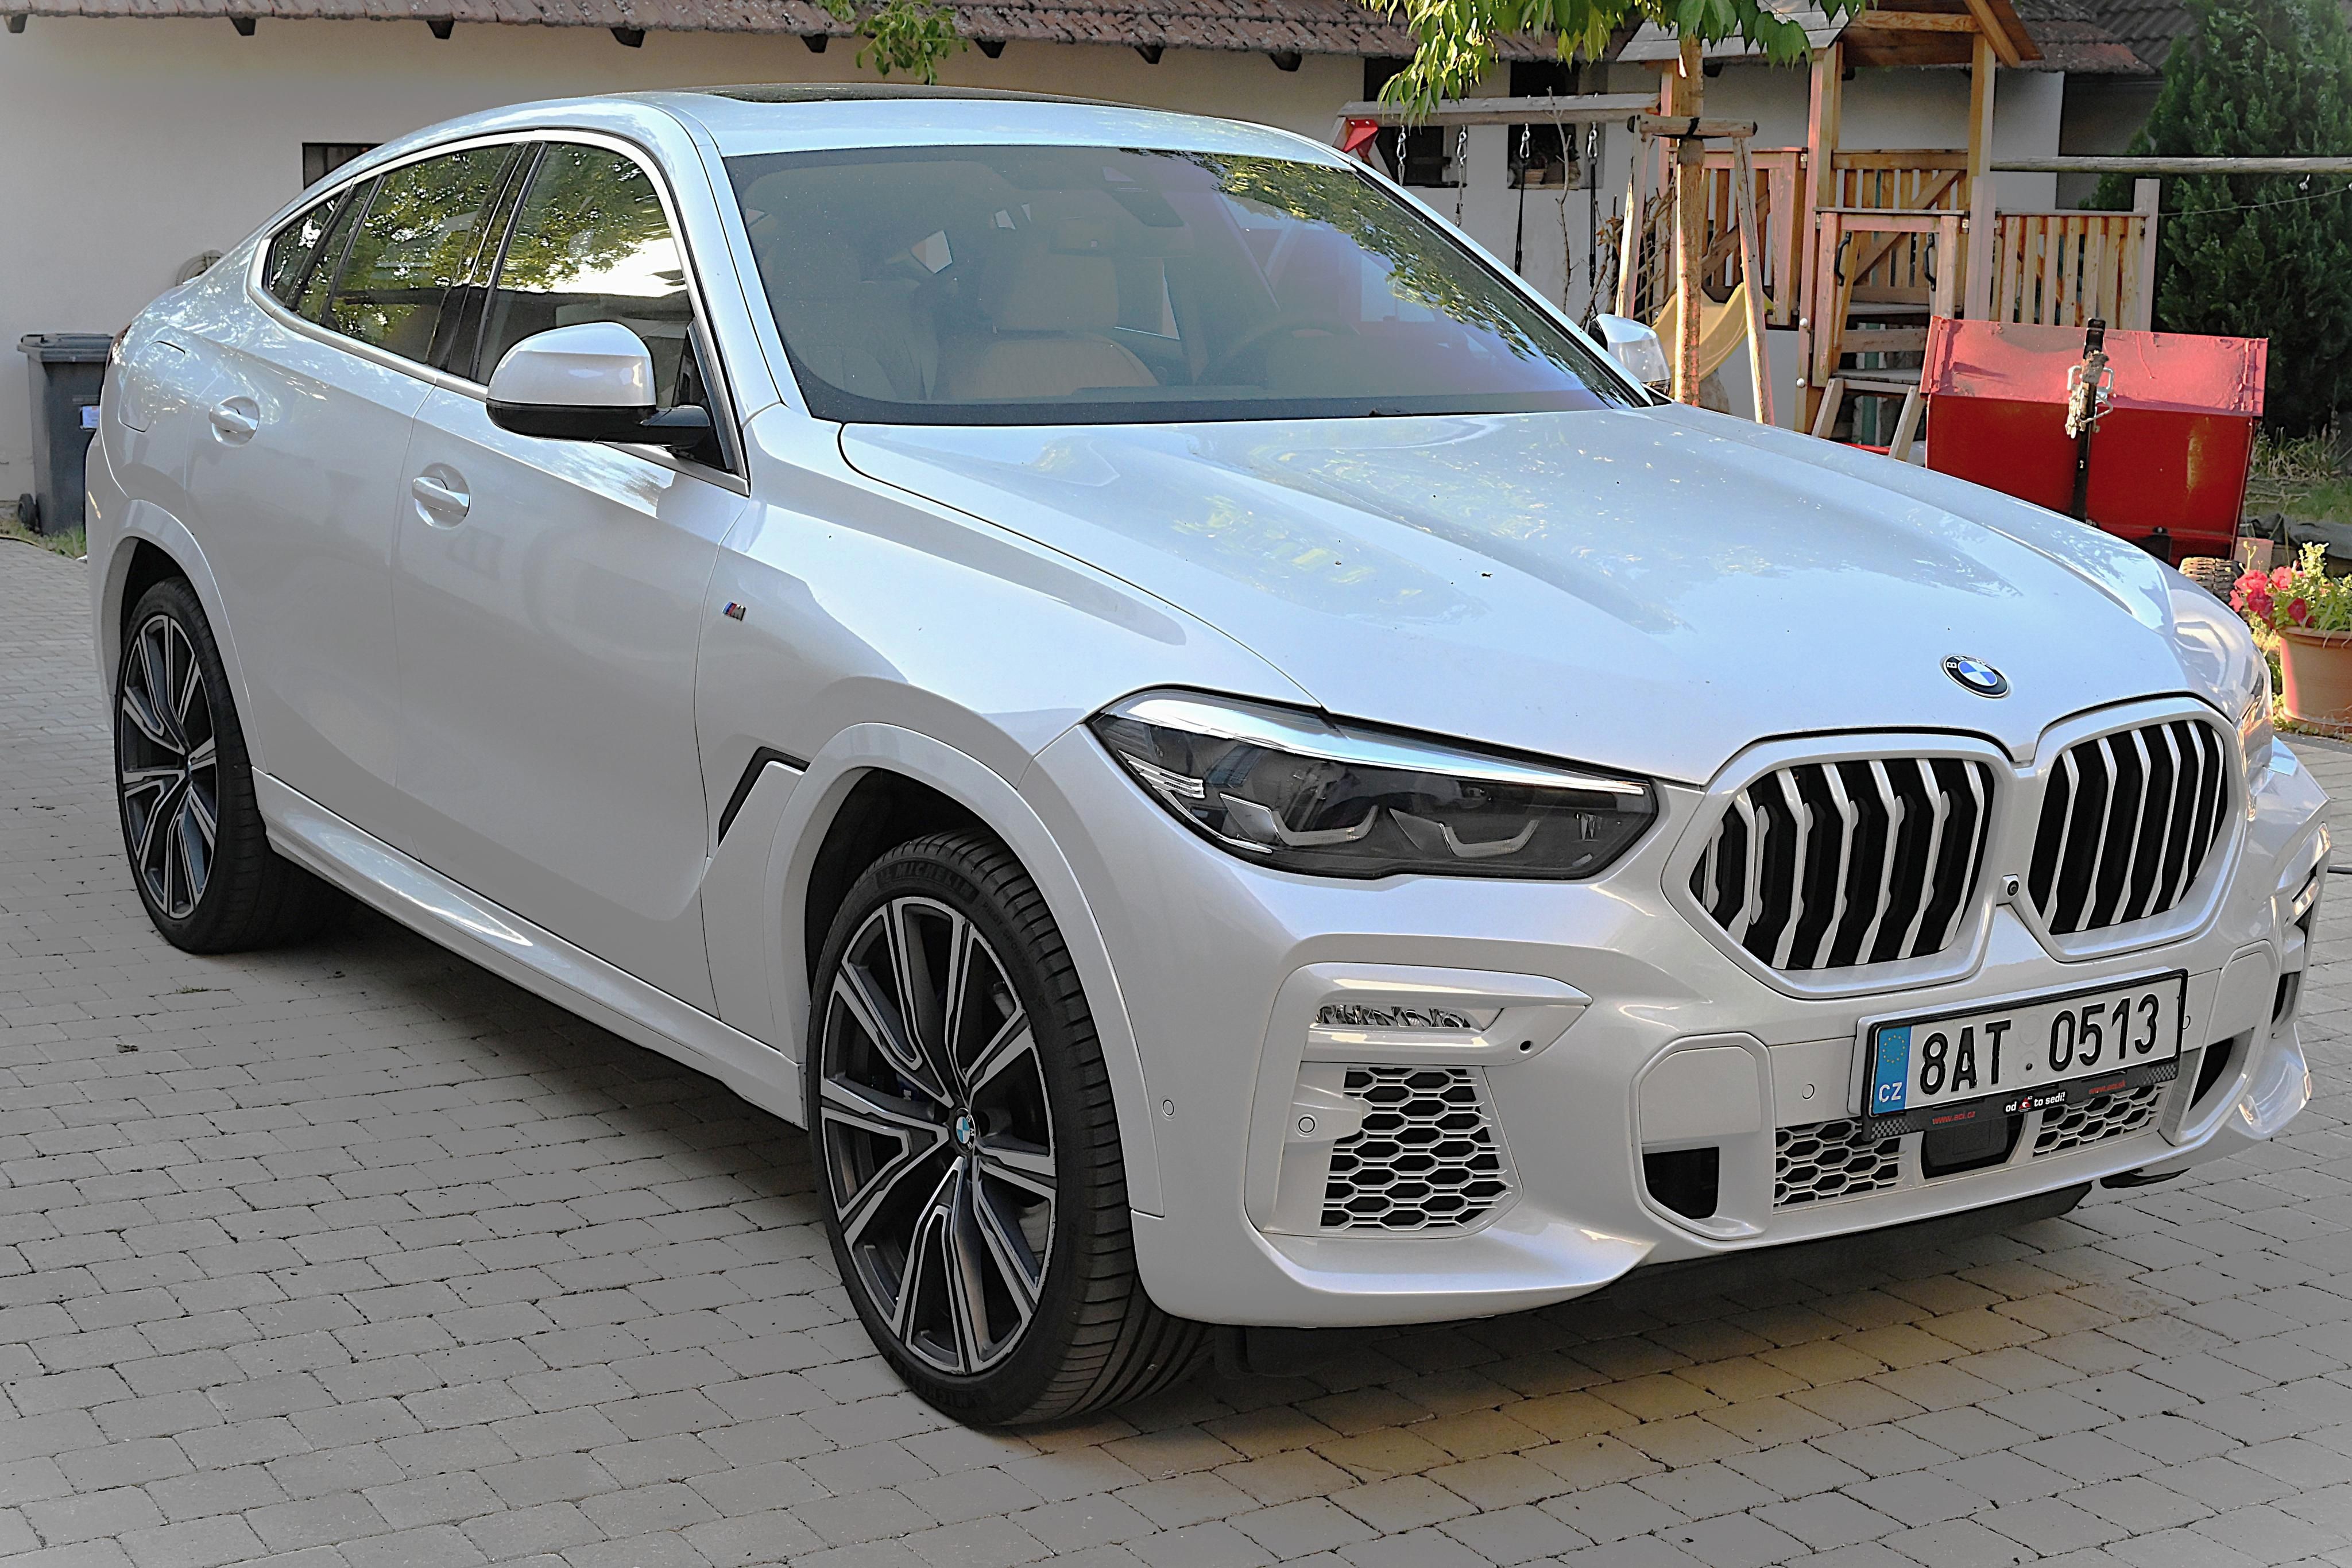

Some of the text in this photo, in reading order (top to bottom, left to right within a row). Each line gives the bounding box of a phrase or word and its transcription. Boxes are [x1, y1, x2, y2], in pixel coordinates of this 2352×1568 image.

[1919, 993, 2160, 1095] 8AT 0513
[1879, 1082, 1902, 1103] CZ
[2005, 1101, 2017, 1112] od
[2034, 1098, 2044, 1107] to
[966, 1114, 975, 1150] BMW
